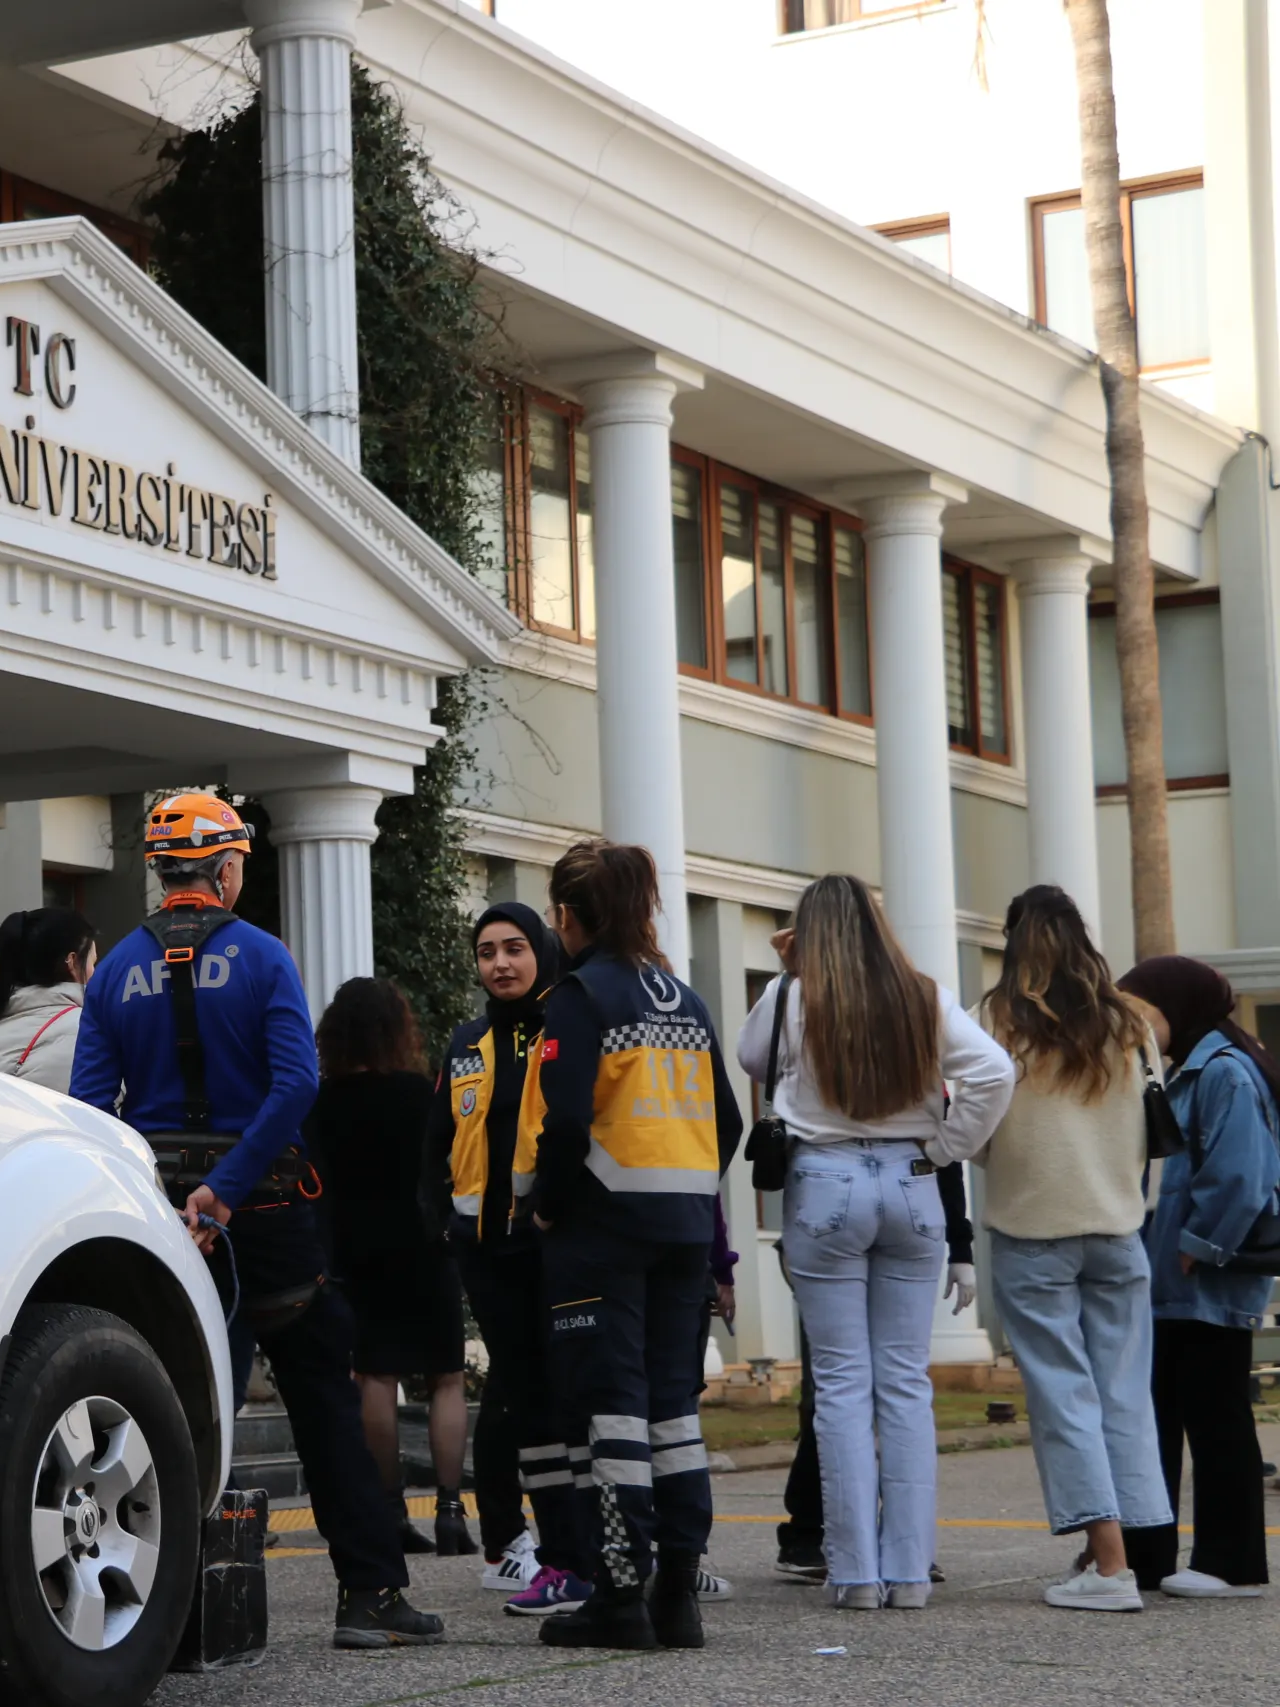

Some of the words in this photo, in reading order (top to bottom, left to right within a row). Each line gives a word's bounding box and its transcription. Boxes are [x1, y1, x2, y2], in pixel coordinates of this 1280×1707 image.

[6, 316, 77, 409] TC
[150, 825, 172, 836] AFAD
[122, 954, 230, 1003] AFD
[647, 1051, 699, 1092] 112
